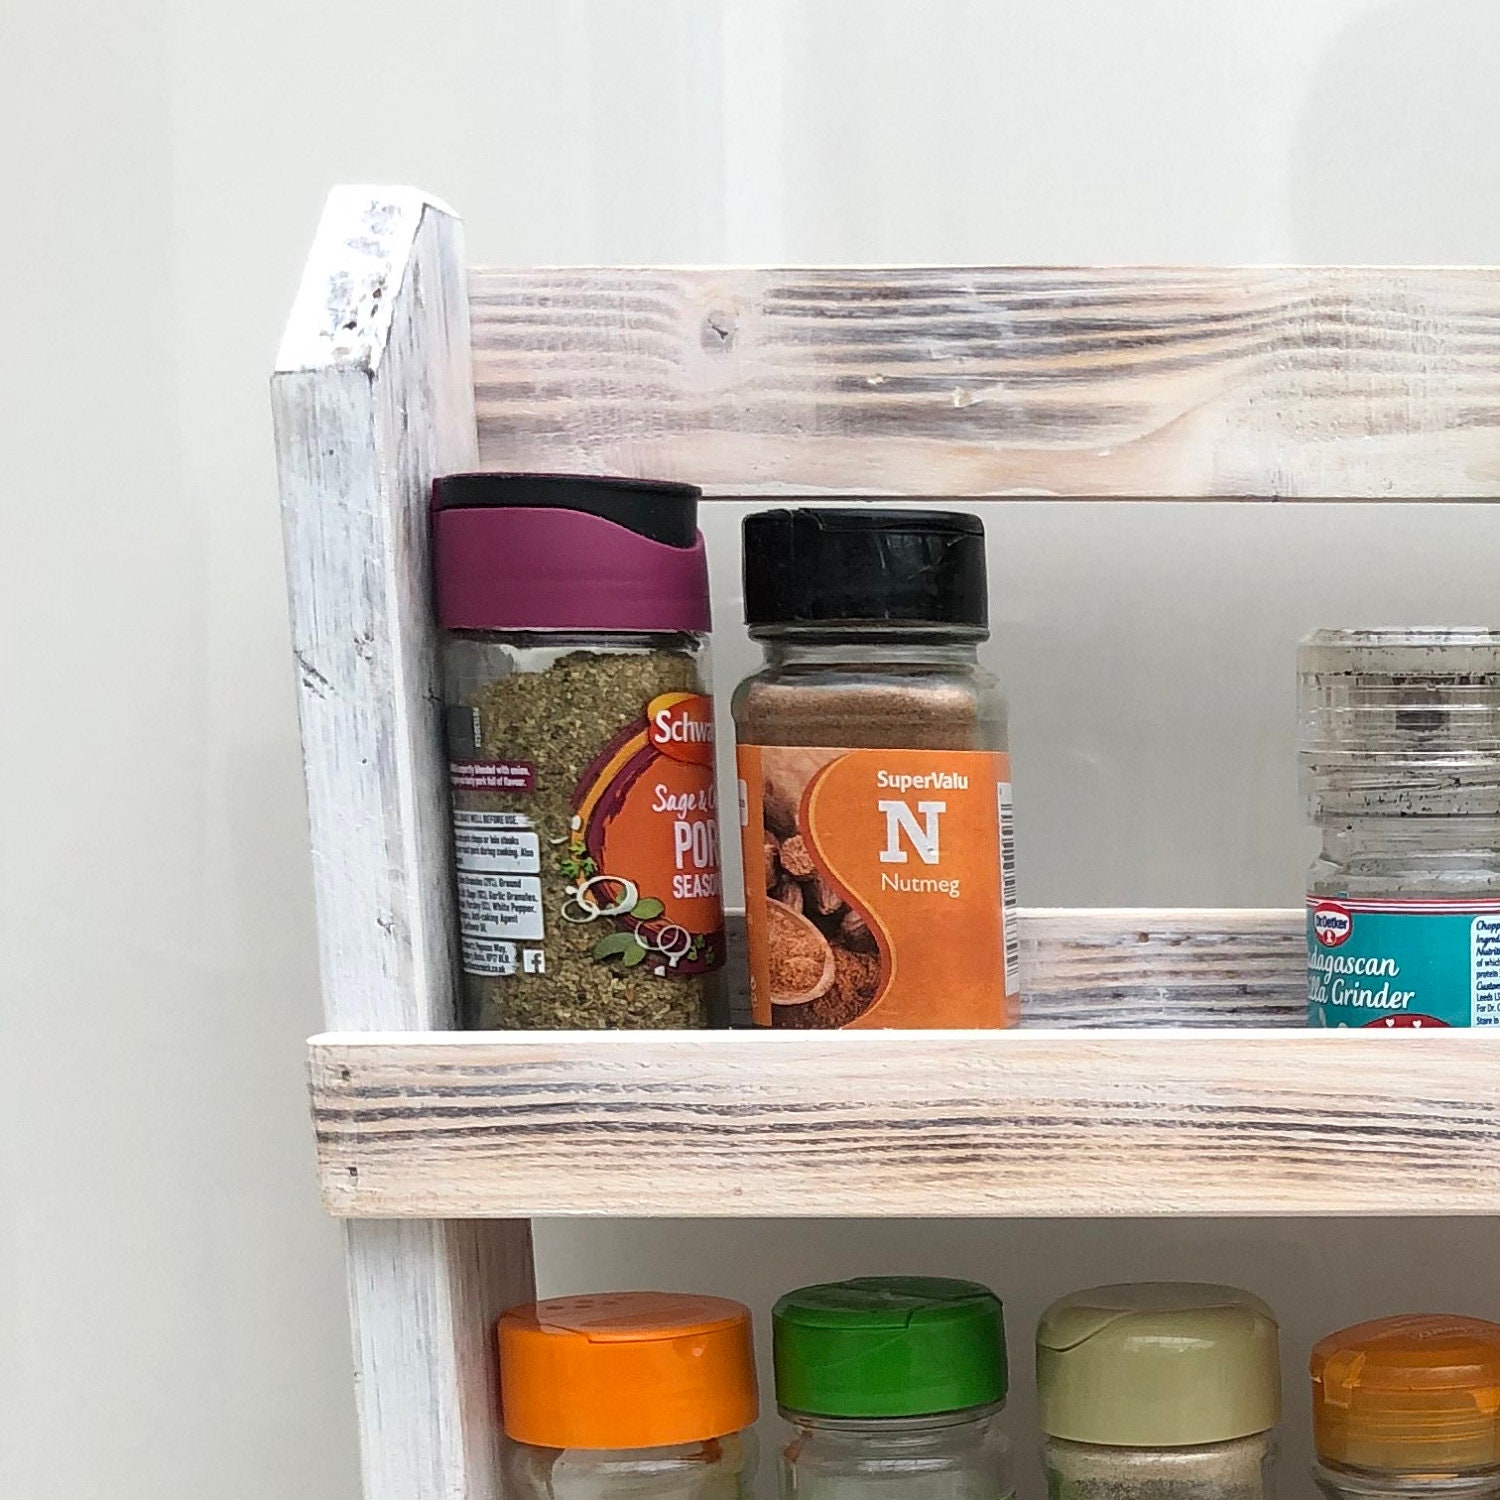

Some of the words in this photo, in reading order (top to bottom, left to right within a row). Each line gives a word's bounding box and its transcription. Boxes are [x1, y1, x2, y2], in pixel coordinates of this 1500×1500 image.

[876, 770, 969, 793] SuperValu
[652, 783, 697, 821] Sage
[698, 795, 708, 814] &
[877, 799, 947, 865] N
[881, 873, 961, 898] Nutmeg
[1331, 978, 1416, 1009] Grinder
[1476, 1003, 1487, 1013] For
